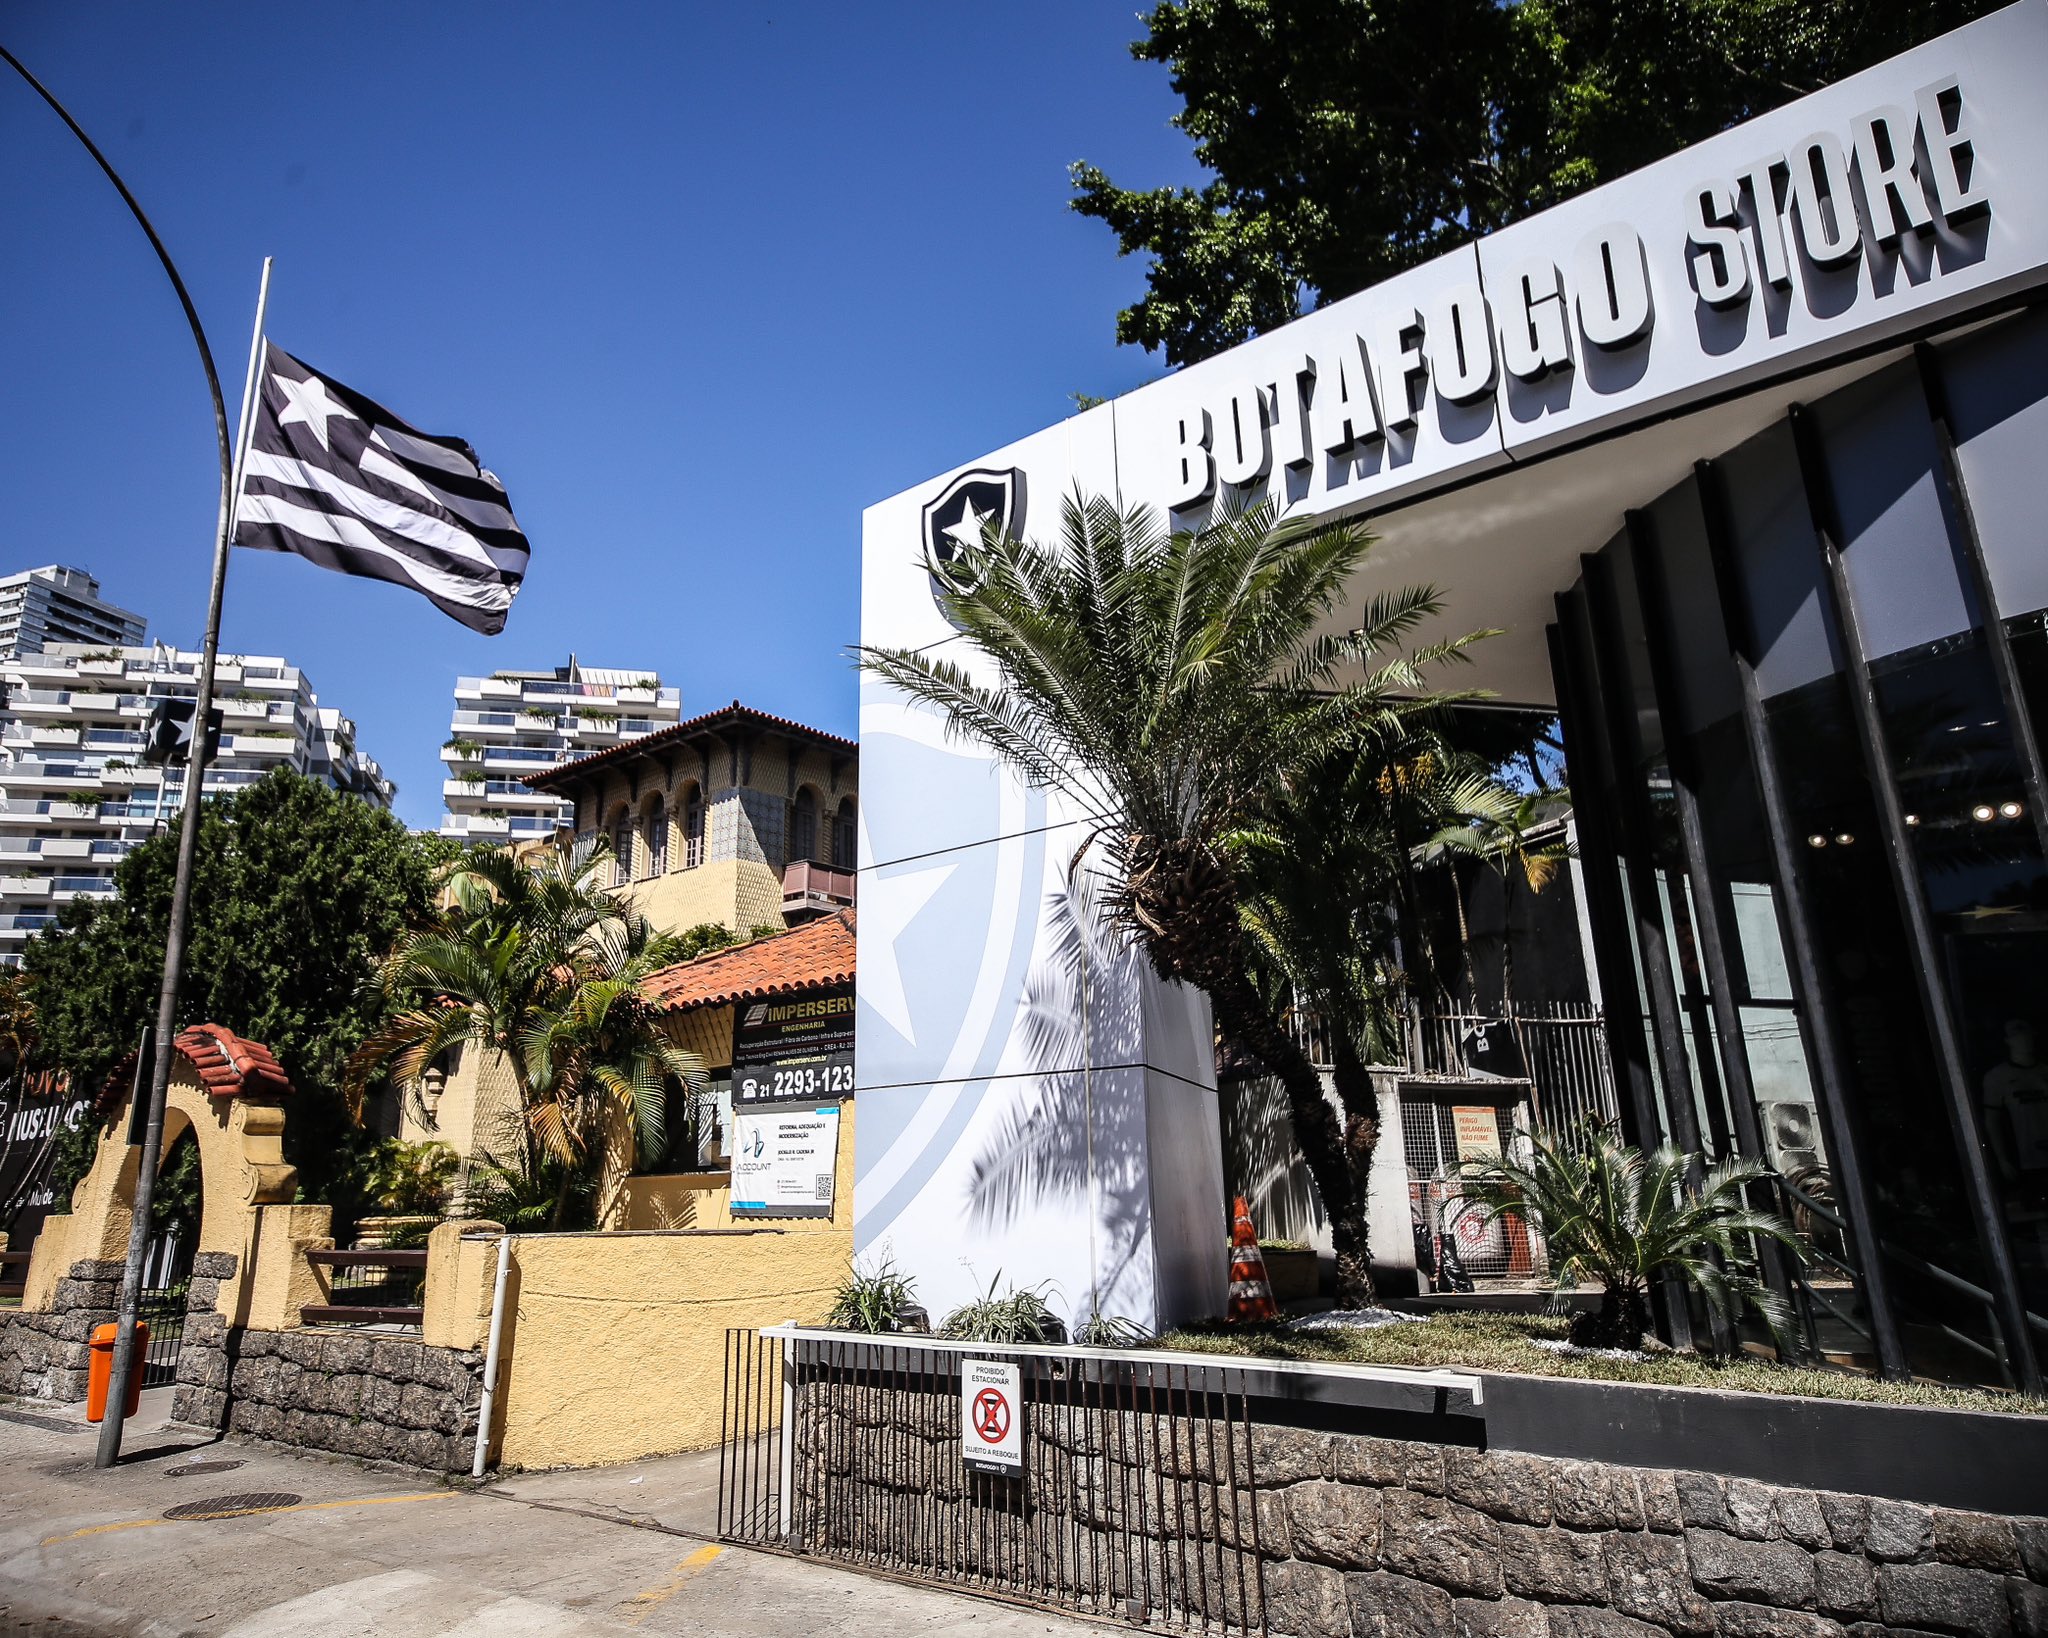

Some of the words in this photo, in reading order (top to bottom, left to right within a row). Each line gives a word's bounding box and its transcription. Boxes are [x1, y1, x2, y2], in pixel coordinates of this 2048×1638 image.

[1168, 222, 1656, 510] BOTAFOGO
[1685, 74, 1990, 305] STORE
[781, 1020, 826, 1033] ENGENHARIA
[759, 1084, 770, 1098] 21
[1459, 1116, 1478, 1124] PERIGO
[798, 1121, 823, 1131] ADEQUAÇÃO
[976, 1366, 1005, 1376] PROIBIDO
[971, 1375, 1010, 1385] ESTACIONAR
[965, 1445, 987, 1455] SUJEITO
[992, 1450, 1019, 1460] REBOQUE
